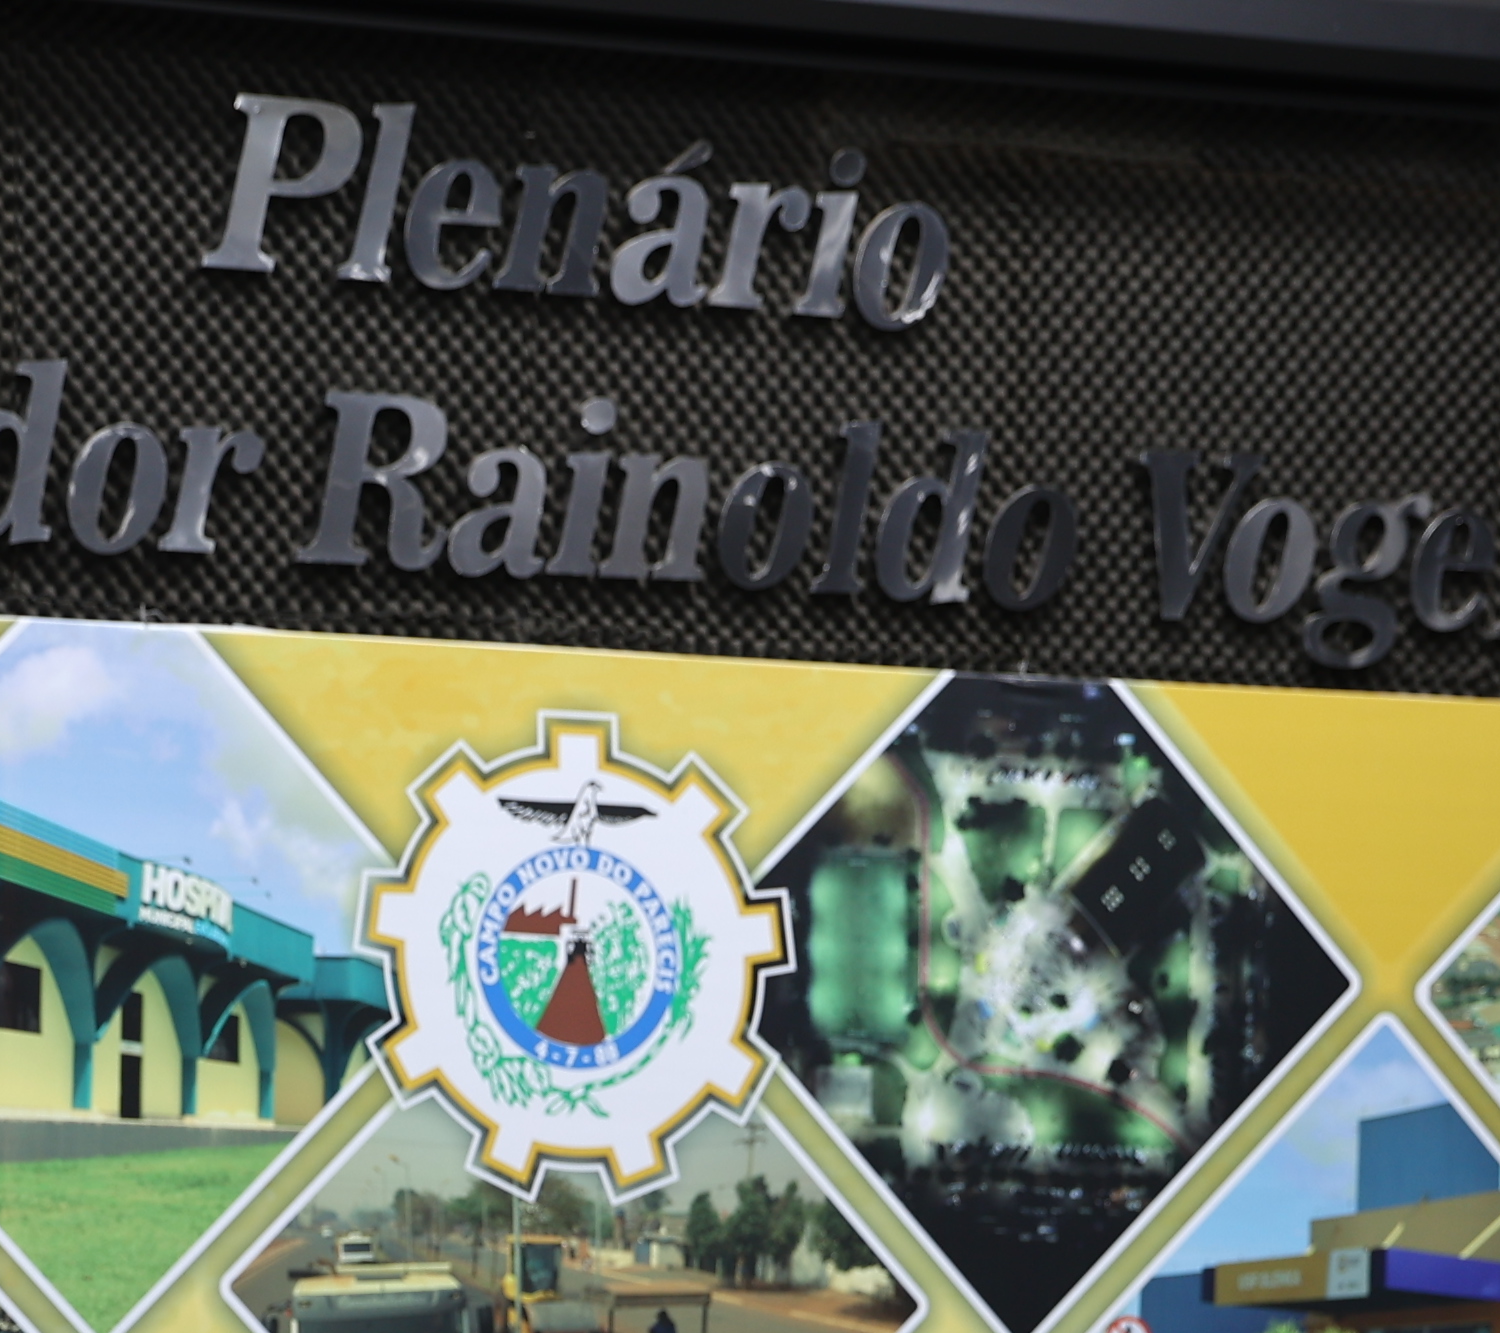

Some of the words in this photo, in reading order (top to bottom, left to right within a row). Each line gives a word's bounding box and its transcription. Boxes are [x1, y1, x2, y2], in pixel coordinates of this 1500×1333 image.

[201, 91, 950, 331] Plenário
[295, 388, 1079, 613] Rainoldo
[478, 881, 519, 986] CAMPO
[515, 849, 592, 886] NOVO
[596, 856, 633, 886] DO
